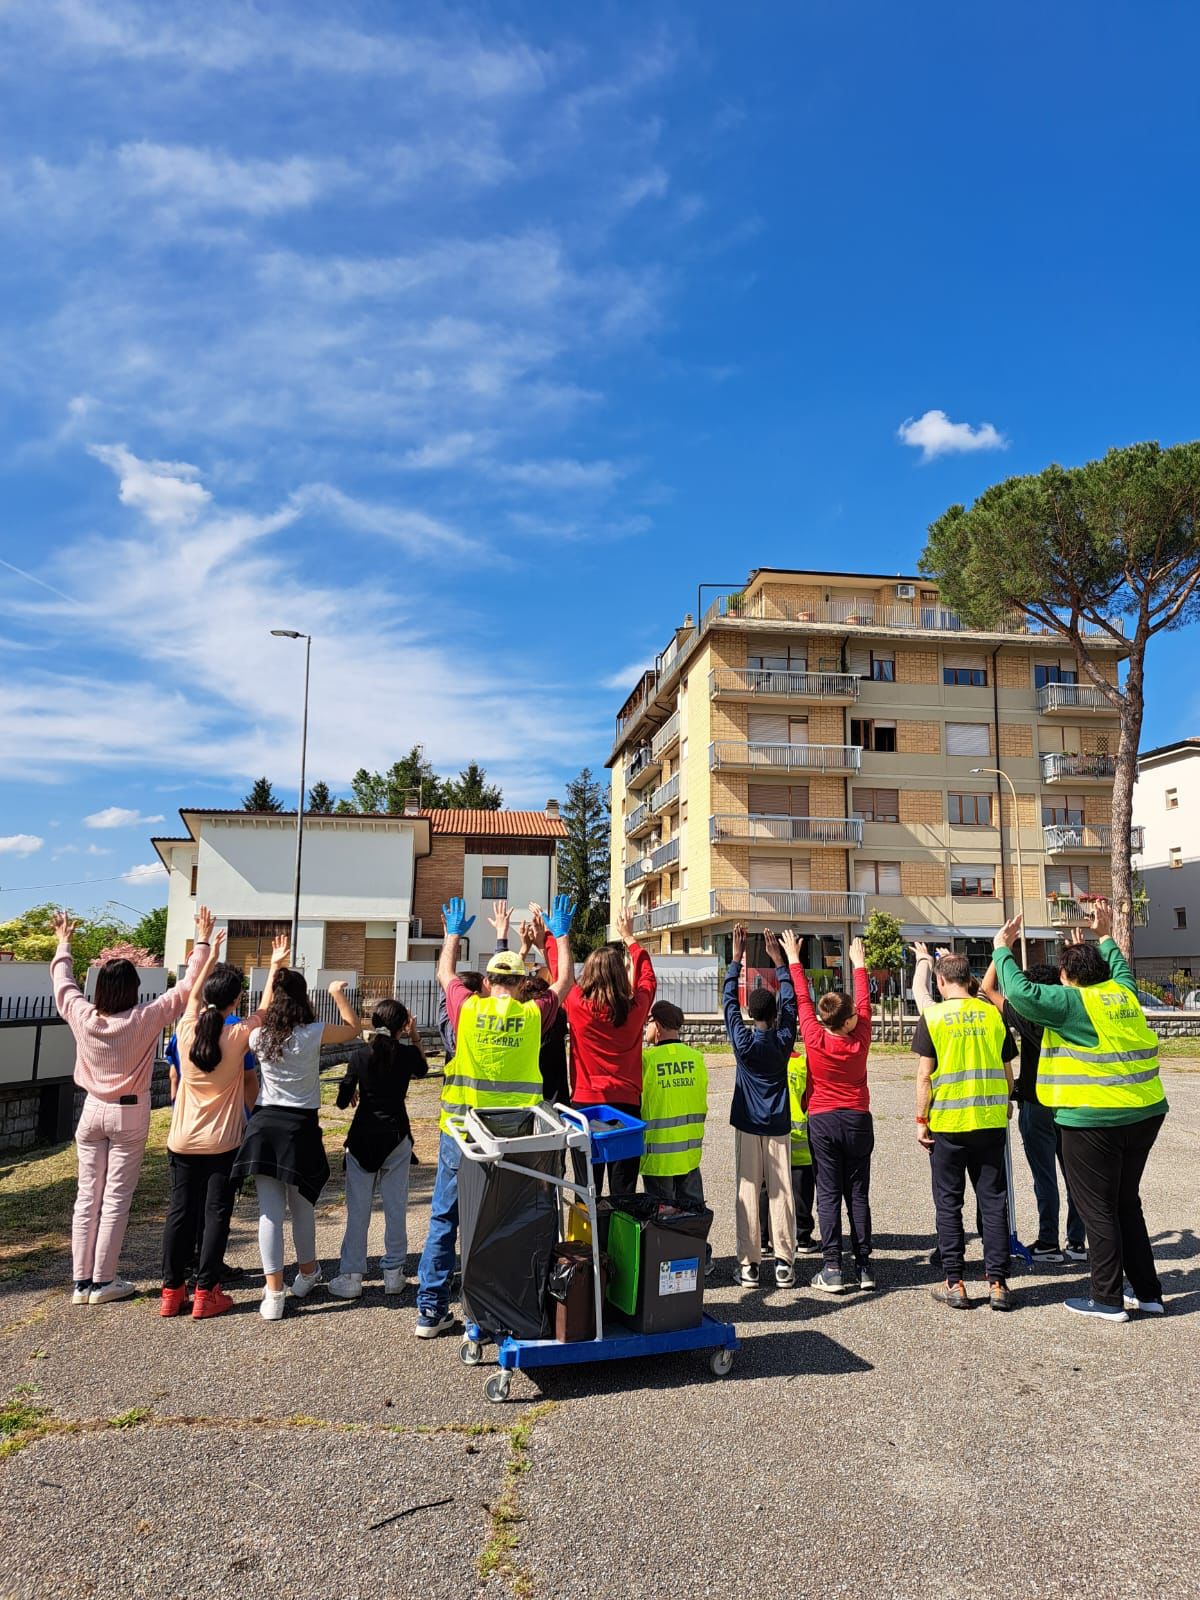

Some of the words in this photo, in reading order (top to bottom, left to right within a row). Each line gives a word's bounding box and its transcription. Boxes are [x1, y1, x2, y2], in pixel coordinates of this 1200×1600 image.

[475, 1013, 525, 1033] STAFF
[943, 1010, 986, 1026] STAFF
[656, 1061, 695, 1077] STAFF
[657, 1079, 671, 1089] "LA
